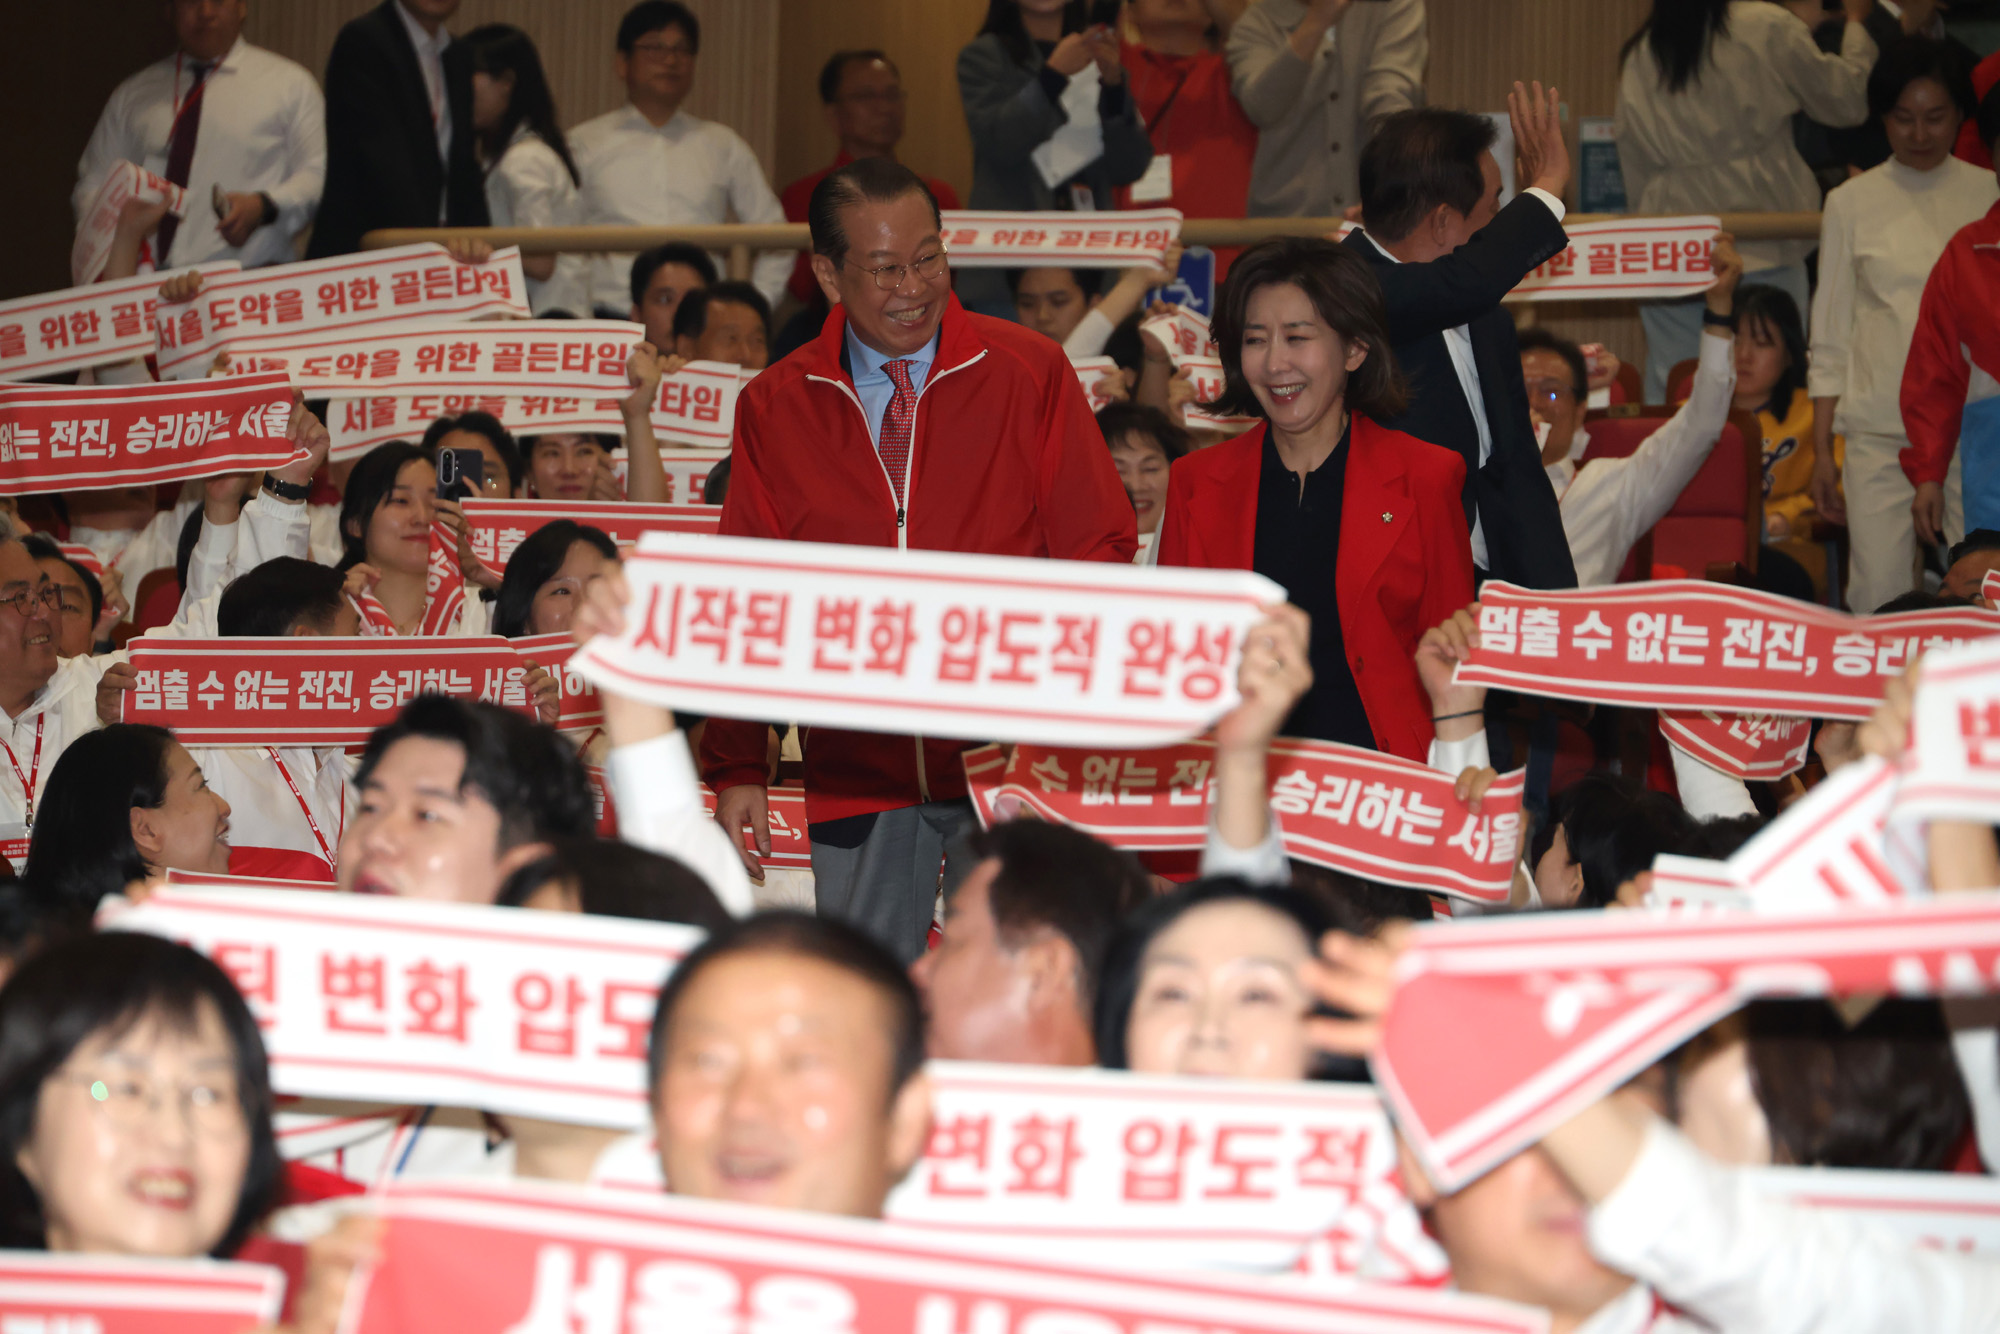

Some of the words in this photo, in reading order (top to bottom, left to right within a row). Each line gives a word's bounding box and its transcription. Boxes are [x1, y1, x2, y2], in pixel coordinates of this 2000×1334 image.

[992, 229, 1047, 246] 위한
[1056, 228, 1171, 251] 골든타임
[1522, 245, 1577, 280] 한
[1587, 240, 1711, 275] 골든타임
[40, 309, 101, 350] 위한
[156, 310, 204, 350] 서울
[209, 288, 304, 332] 도약을
[318, 276, 380, 317] 위한
[391, 266, 513, 305] 골든타임
[298, 348, 401, 380] 도약을
[414, 341, 481, 374] 위한
[492, 341, 628, 376] 골든타임
[0, 421, 40, 462] 없는
[49, 418, 117, 459] 전진,
[126, 409, 233, 454] 승리하는
[238, 400, 292, 438] 서울
[341, 396, 398, 433] 서울
[631, 583, 791, 664] 시작된
[812, 595, 918, 677] 변화
[937, 606, 1100, 692] 압도적
[1121, 620, 1231, 701] 완성
[1480, 606, 1560, 658] 멈출
[1572, 611, 1613, 659] 수
[1626, 611, 1709, 666] 없는
[1722, 618, 1819, 677] 전진,
[134, 669, 189, 711] 멈출
[197, 671, 225, 711] 수
[233, 670, 288, 711] 없는
[297, 670, 360, 713] 전진,
[369, 668, 472, 711] 승리하는
[478, 667, 528, 707] 서울
[1080, 755, 1158, 806] 없는
[1169, 759, 1218, 806] 전
[1269, 768, 1443, 847] 승리하는
[1447, 810, 1520, 864] 서울
[320, 950, 476, 1042] 변화
[924, 1111, 1086, 1201] 변화
[1120, 1117, 1371, 1206] 압도적
